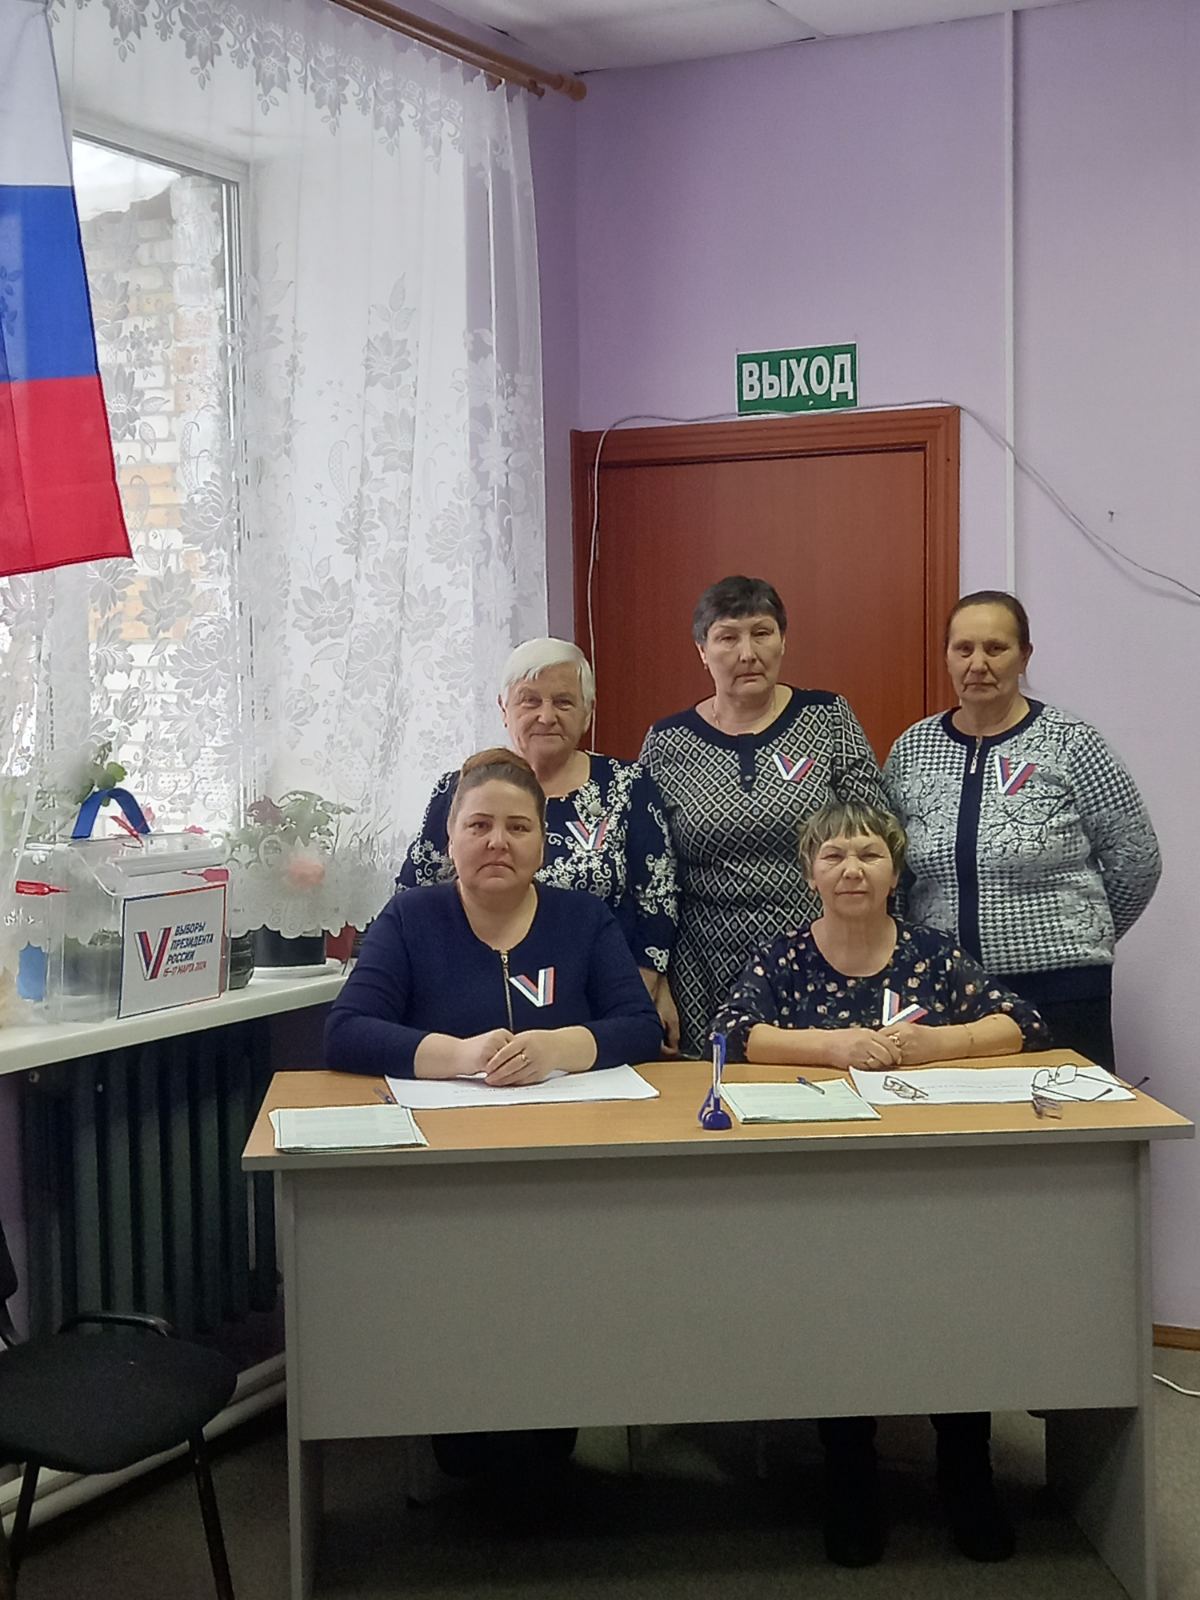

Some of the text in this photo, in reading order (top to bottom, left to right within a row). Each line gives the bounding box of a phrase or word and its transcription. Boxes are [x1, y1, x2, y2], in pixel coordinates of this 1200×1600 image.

[742, 353, 854, 402] ВЫХОД
[174, 921, 206, 936] ВЫБОРЫ
[170, 933, 214, 950] ПРЕЗИДЕНТА
[166, 949, 196, 965] РОССИИ
